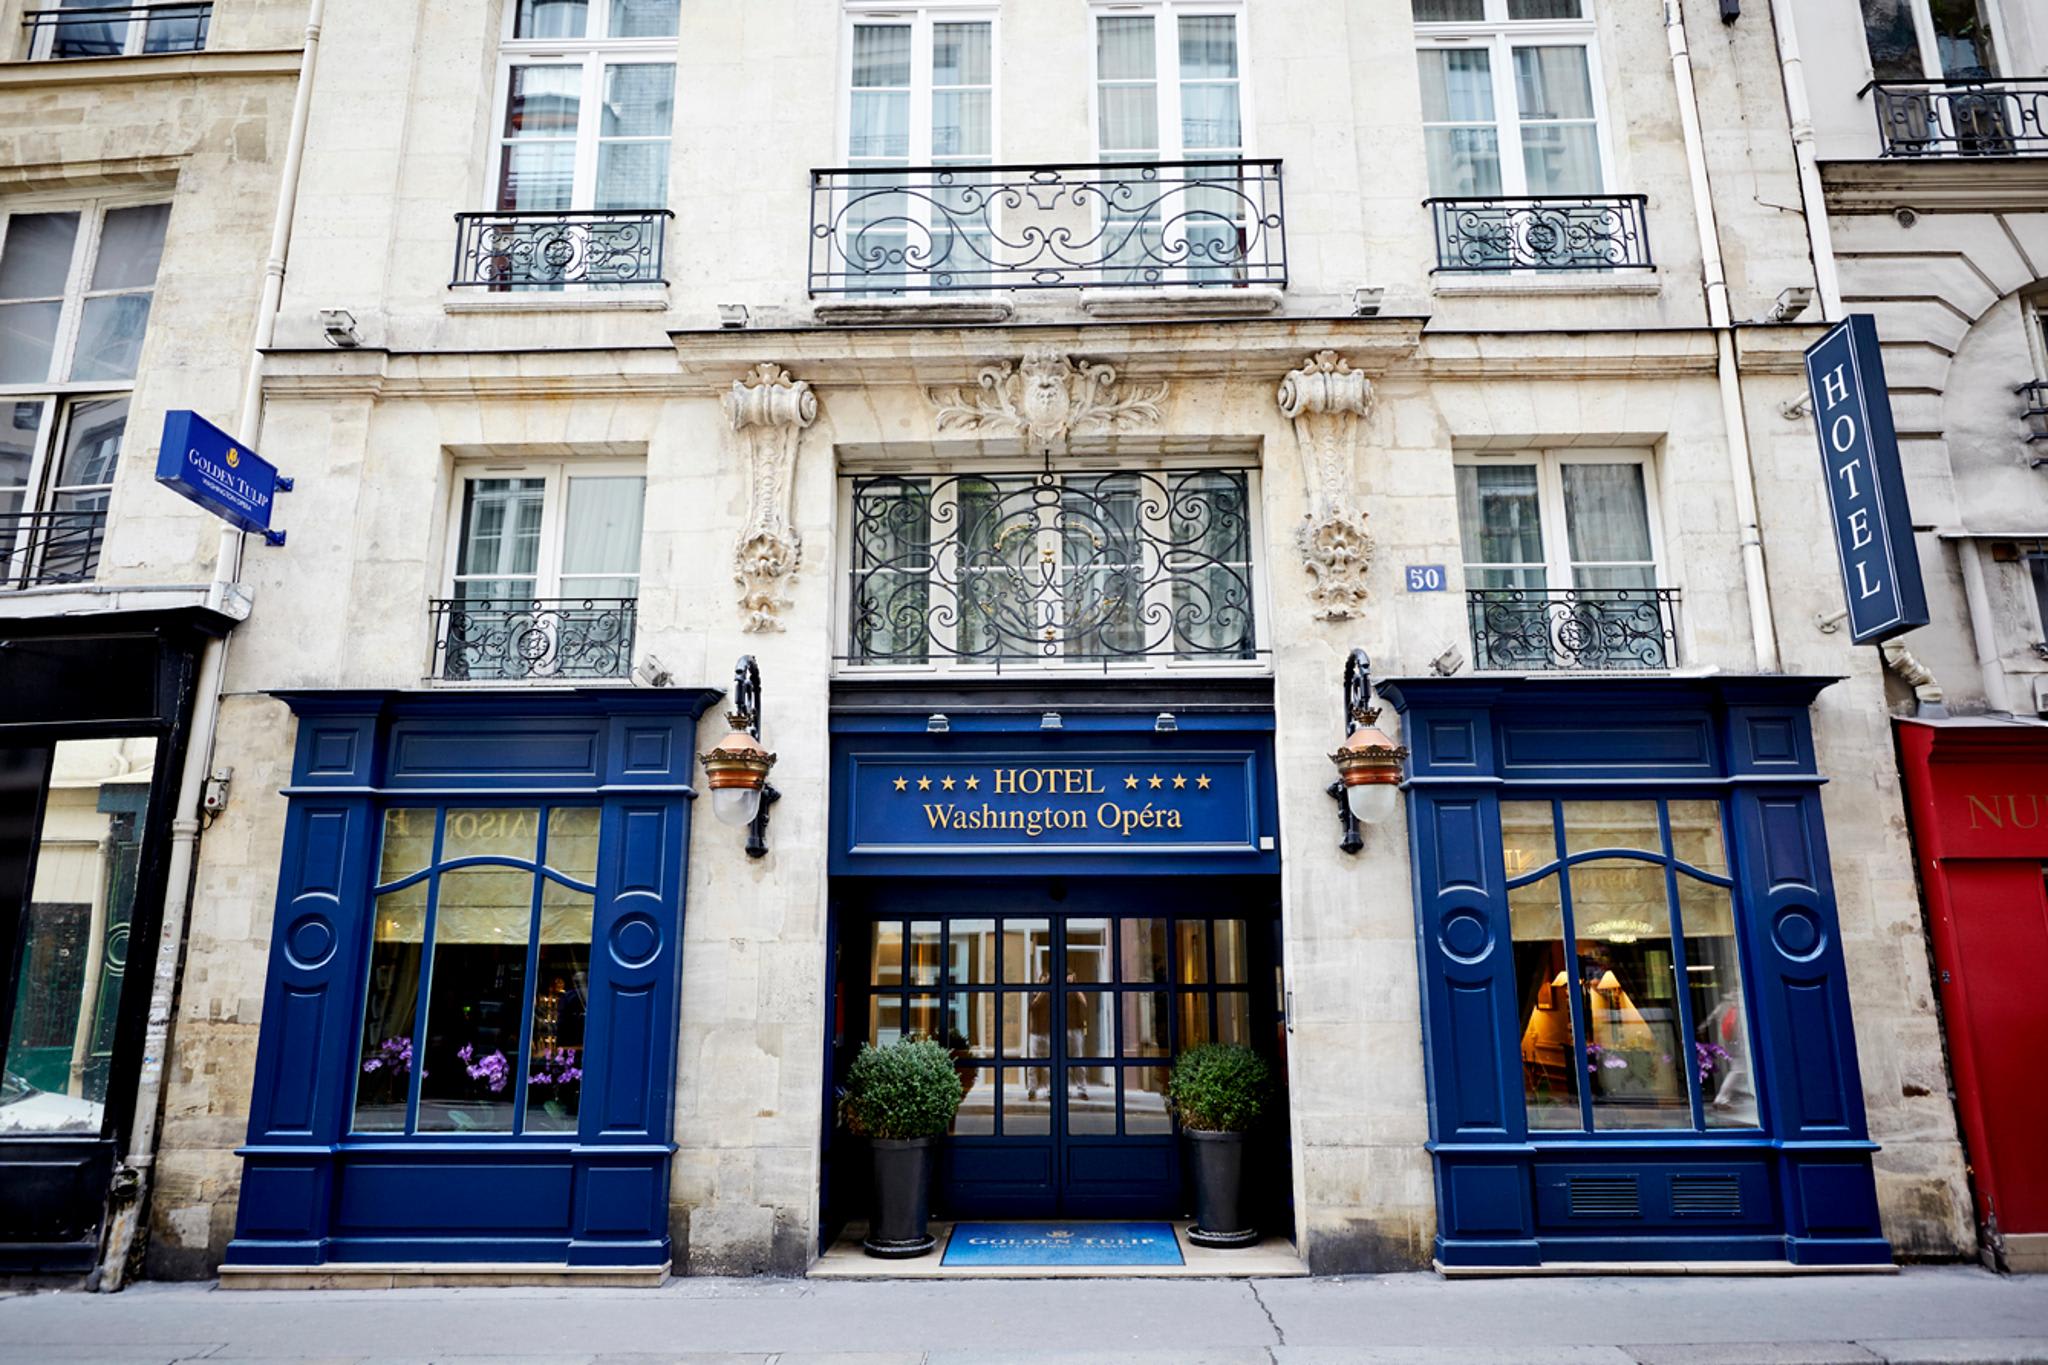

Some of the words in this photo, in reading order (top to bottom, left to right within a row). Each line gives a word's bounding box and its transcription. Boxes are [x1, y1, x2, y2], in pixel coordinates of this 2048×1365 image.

[189, 448, 235, 487] GOLDEN
[237, 477, 269, 507] TULIP
[1821, 363, 1881, 600] HOTEL
[1410, 568, 1440, 590] 50
[992, 768, 1106, 795] HOTEL
[924, 803, 1088, 837] Washington
[1096, 802, 1183, 837] Opéra
[1964, 794, 2048, 829] NU
[968, 1237, 1070, 1246] GOLDEN
[1080, 1237, 1155, 1246] TULIP
